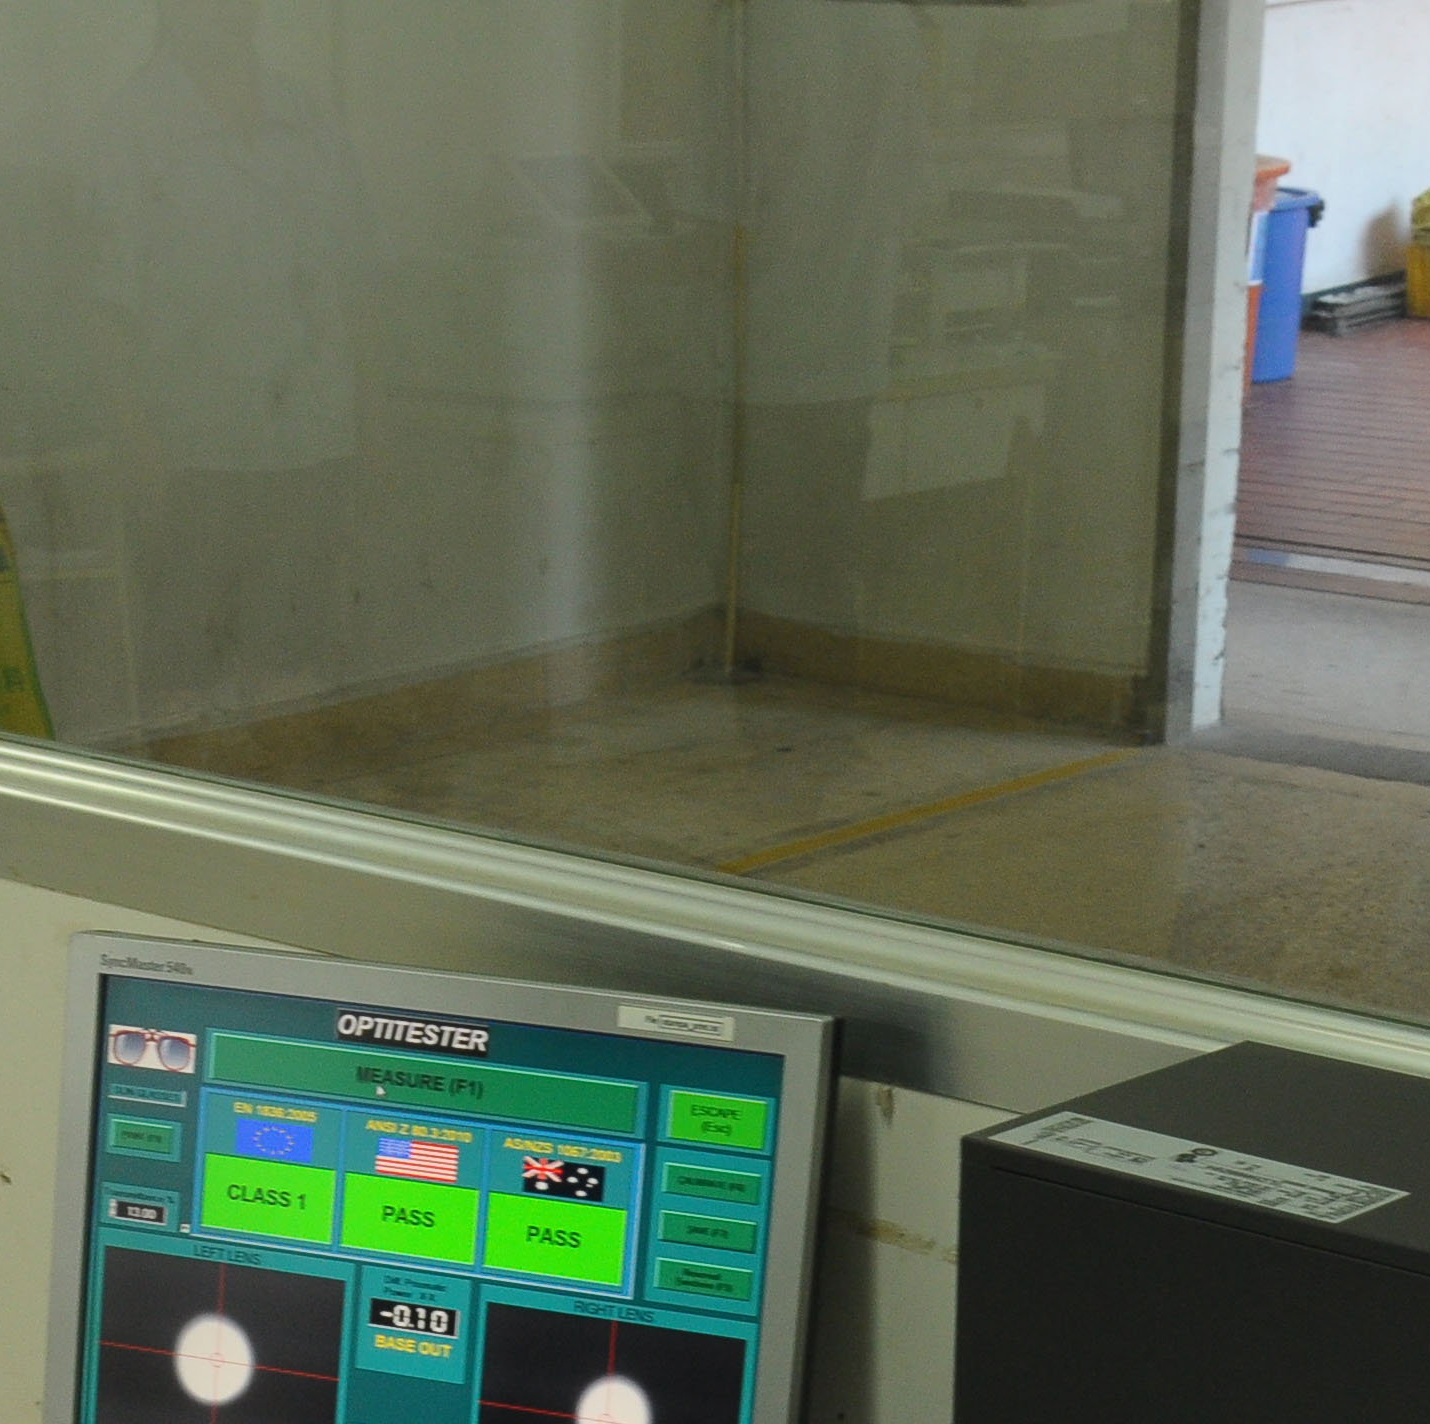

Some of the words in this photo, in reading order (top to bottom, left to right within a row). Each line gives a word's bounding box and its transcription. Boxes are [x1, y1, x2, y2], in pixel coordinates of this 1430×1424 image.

[338, 1013, 488, 1053] OPTITESTER
[357, 1065, 444, 1092] MEASURE
[450, 1076, 484, 1100] (F1)
[233, 1101, 254, 1114] EN
[690, 1104, 741, 1122] ESCAPE
[366, 1119, 398, 1133] ANSI
[400, 1123, 409, 1135] Z
[701, 1118, 731, 1137] (Esc)
[227, 1183, 291, 1208] CLASS
[298, 1192, 306, 1210] 1
[381, 1204, 436, 1228] PASS
[526, 1224, 582, 1249] PASS
[193, 1244, 226, 1261] LEFT
[228, 1248, 261, 1265] LENS
[379, 1304, 449, 1335] -0.10
[574, 1300, 612, 1318] RIGHT
[616, 1306, 655, 1323] LENS
[375, 1335, 416, 1353] BASE
[418, 1340, 452, 1359] OUT
